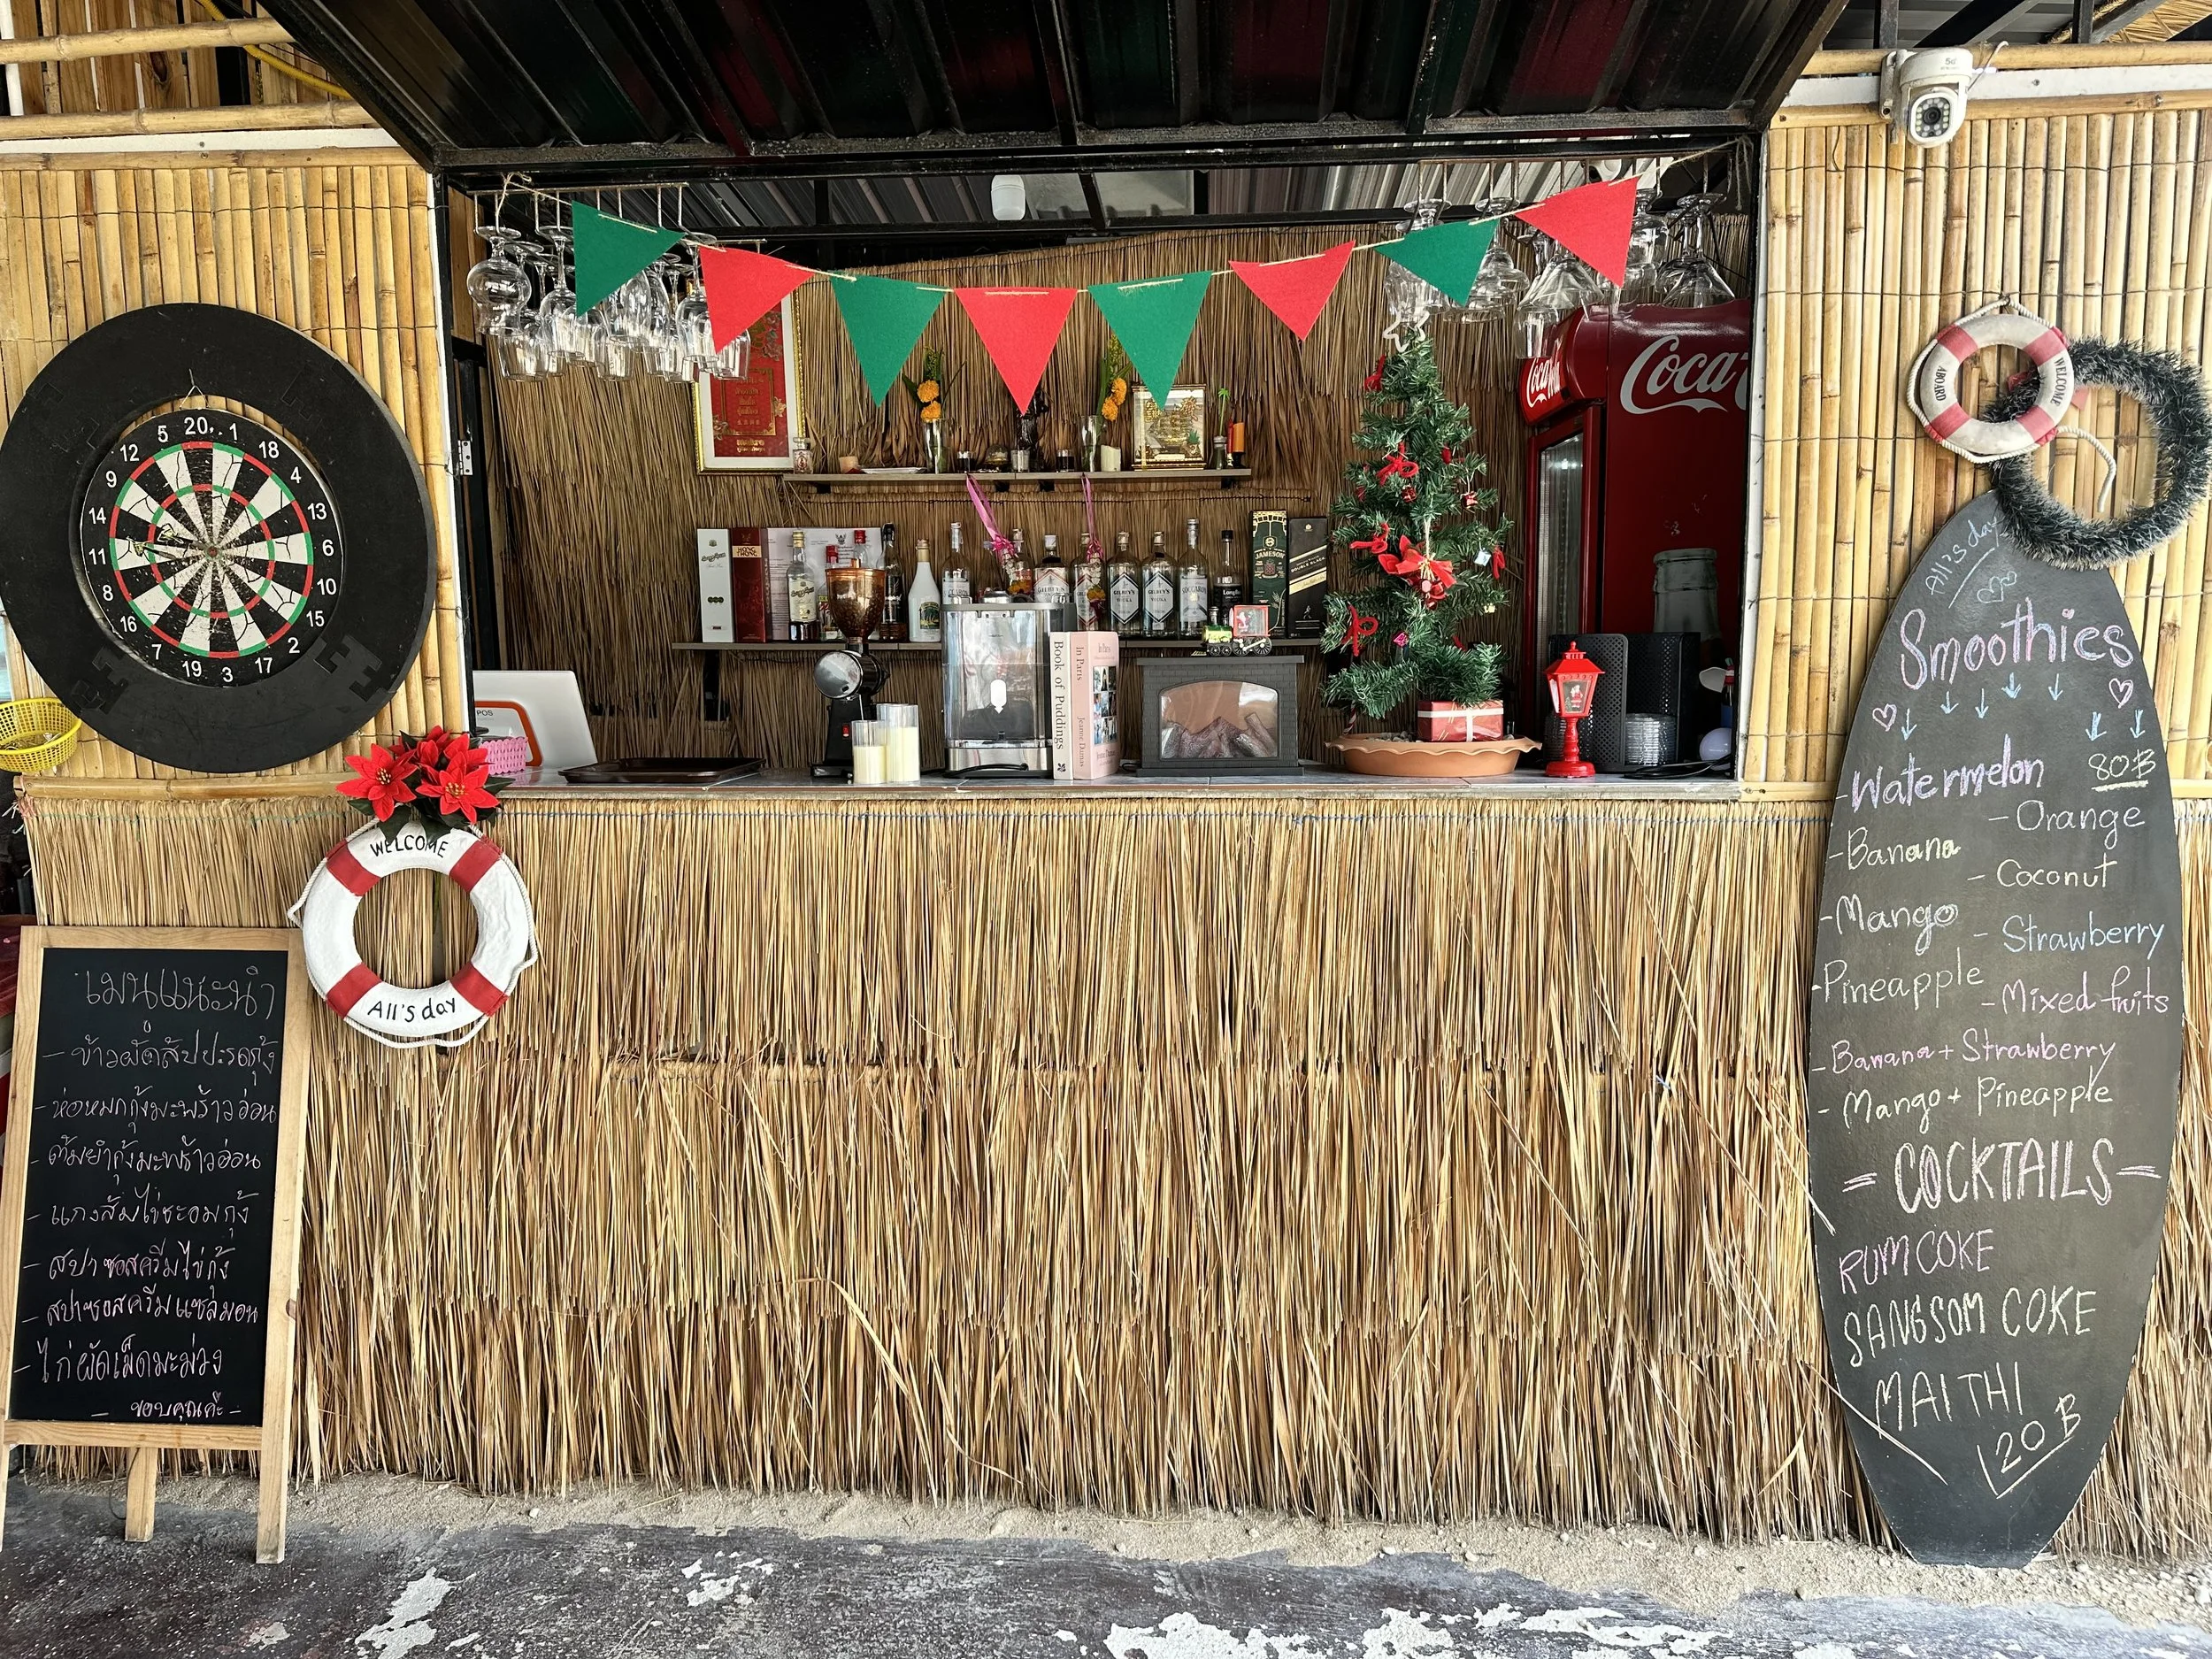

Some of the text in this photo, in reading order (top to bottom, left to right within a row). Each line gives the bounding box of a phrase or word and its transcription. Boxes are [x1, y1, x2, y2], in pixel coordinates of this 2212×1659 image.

[1934, 365, 1947, 403] ABOARD
[2050, 357, 2068, 407] WELCOME
[157, 425, 169, 442] 5
[184, 417, 208, 435] 20
[229, 423, 238, 440] 1
[119, 444, 139, 462] 12
[259, 442, 280, 459] 18
[105, 471, 118, 488] 9
[290, 467, 302, 484] 4
[88, 507, 107, 525] 14
[307, 503, 327, 520] 13
[1968, 516, 2000, 548] day
[88, 548, 106, 565] 11
[322, 539, 334, 557] 6
[1255, 550, 1286, 560] JAMESON
[1290, 563, 1310, 573] DOUBLE
[1310, 557, 1325, 565] BLACK
[102, 584, 114, 602] 8
[316, 578, 336, 595] 10
[119, 616, 137, 633] 16
[306, 611, 325, 627] 15
[151, 643, 163, 660] 7
[288, 637, 300, 654] 2
[1900, 595, 2134, 690] Smoothies
[182, 661, 202, 678] 19
[254, 657, 273, 674] 17
[1075, 646, 1085, 681] In Paris
[222, 664, 234, 682] 3
[1054, 641, 1066, 750] Book of Puddings
[1851, 733, 2045, 813] Watermelon
[2016, 799, 2146, 850] Orange
[1847, 826, 1962, 871] Banana
[1996, 852, 2118, 888] Coconut
[1836, 893, 1959, 956] Mango
[2001, 911, 2166, 960] Strawberry
[1824, 947, 1985, 1010] Pineapple
[2001, 964, 2170, 1016] Mixed fruits
[367, 997, 457, 1023] All's day
[1831, 1039, 1935, 1074] Banana
[1962, 1027, 2116, 1081] Strawberry
[1843, 1088, 1941, 1133] Mango
[1977, 1064, 2114, 1118] Pineapple
[1894, 1137, 2115, 1213] COCKTAILS
[1839, 1228, 1994, 1294] RUM COKE
[1843, 1285, 2097, 1368] SANGSOM COKE
